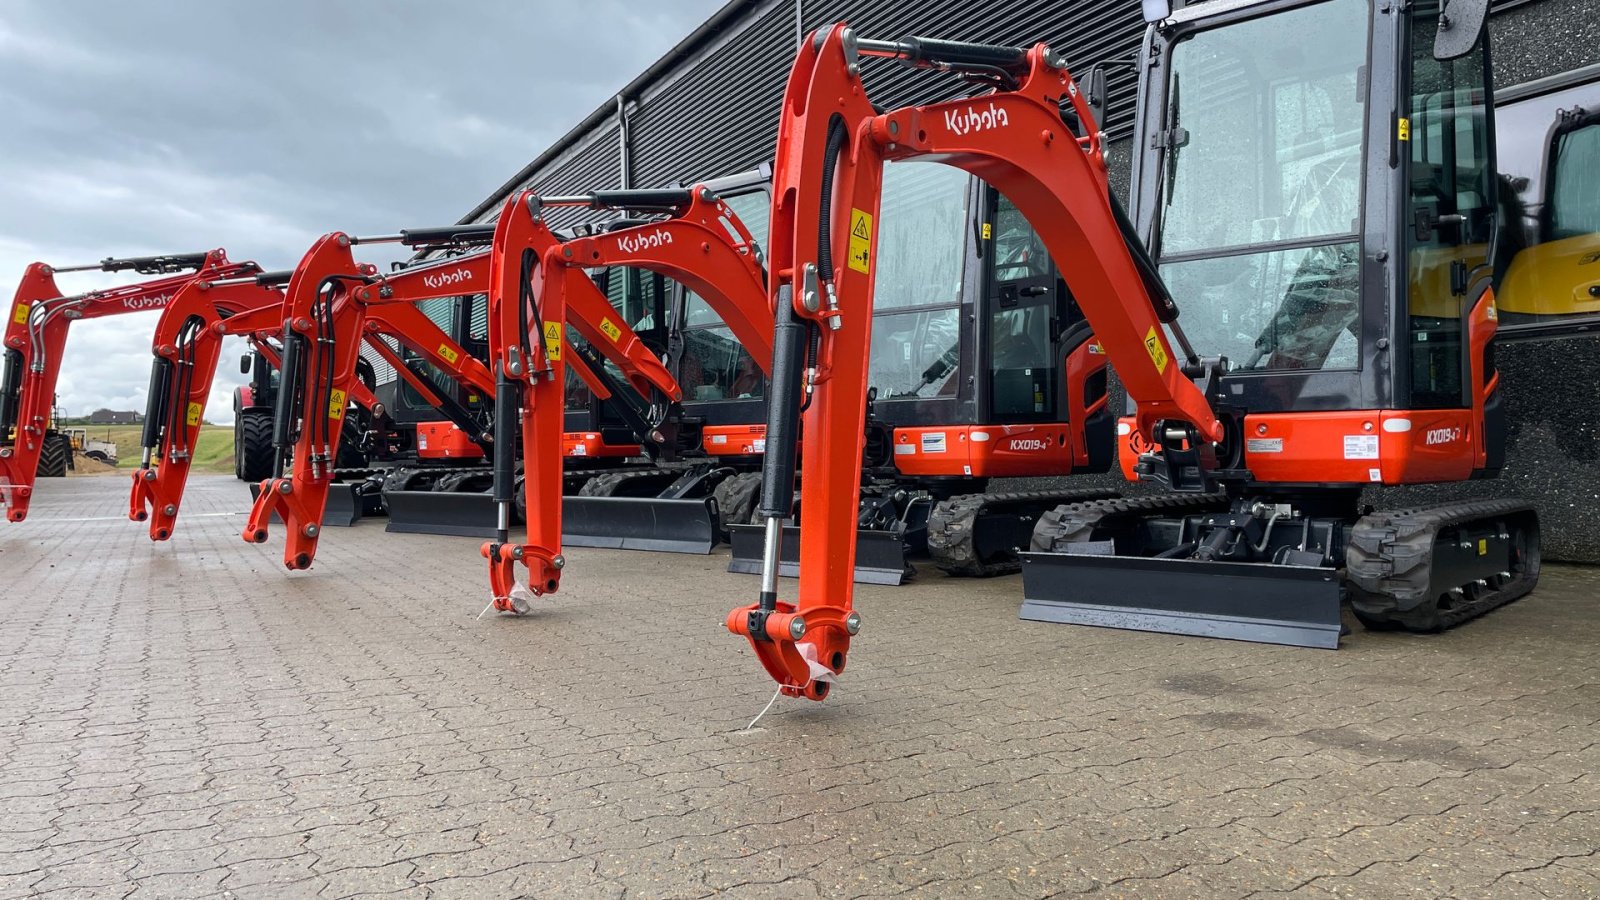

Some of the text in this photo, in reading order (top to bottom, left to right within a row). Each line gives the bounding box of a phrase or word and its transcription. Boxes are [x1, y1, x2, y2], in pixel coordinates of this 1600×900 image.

[944, 102, 1009, 136] Kubota
[617, 228, 673, 253] Kubota
[423, 268, 473, 288] Kubota
[1010, 439, 1047, 450] KX019-4
[1426, 427, 1456, 445] KX019-4
